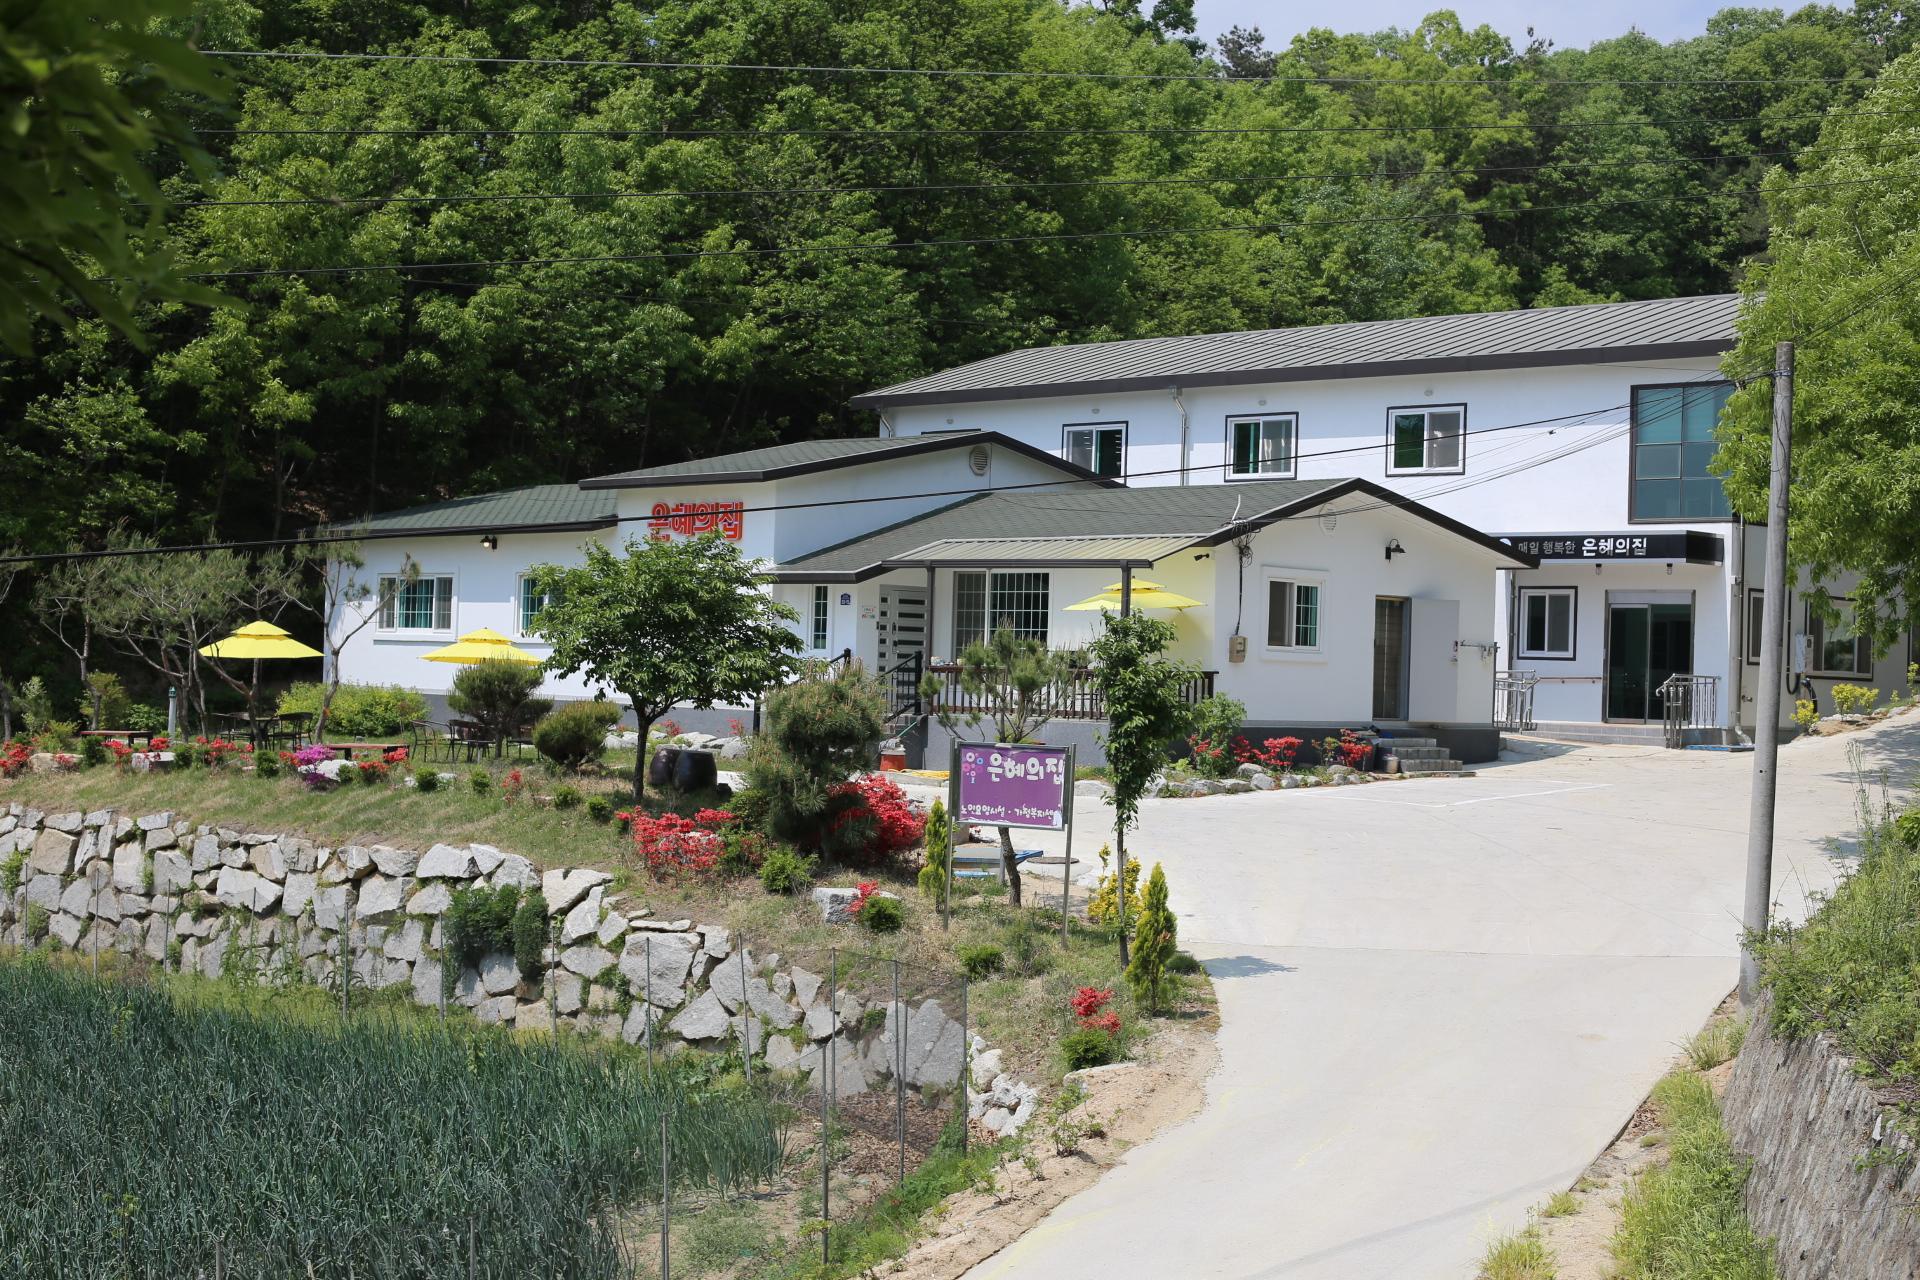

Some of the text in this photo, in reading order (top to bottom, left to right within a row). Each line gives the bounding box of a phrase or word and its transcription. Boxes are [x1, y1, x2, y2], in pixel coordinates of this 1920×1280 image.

[647, 501, 743, 541] 은혜의집
[1518, 537, 1647, 556] 매일 행복한 은혜의집
[987, 755, 1064, 785] 은혜의집
[961, 804, 1060, 819] 노인요양시설 가정복지센
